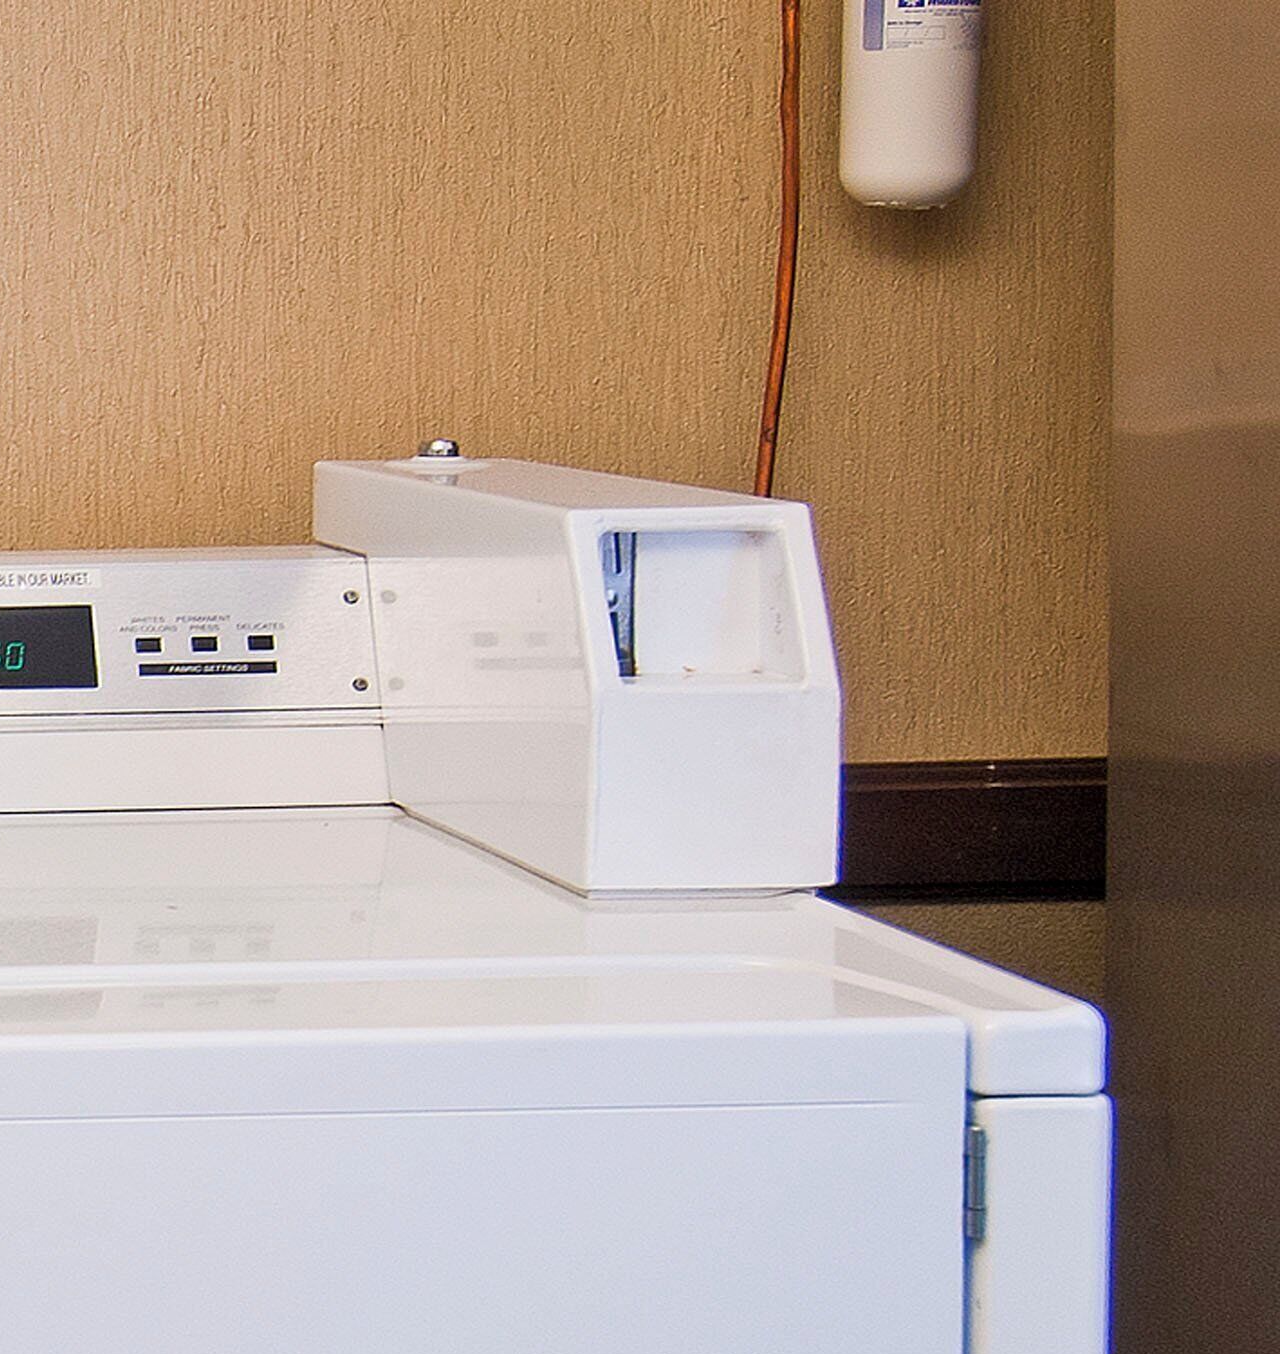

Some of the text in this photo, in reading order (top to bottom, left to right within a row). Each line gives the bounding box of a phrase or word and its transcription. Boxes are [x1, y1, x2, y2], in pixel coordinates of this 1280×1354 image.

[17, 574, 27, 587] IN
[28, 573, 49, 587] OUR
[176, 614, 232, 623] PERMANENT
[189, 624, 221, 632] PRESS
[236, 623, 285, 631] DELICATES
[168, 663, 251, 673] FABRIC SETTINGS
